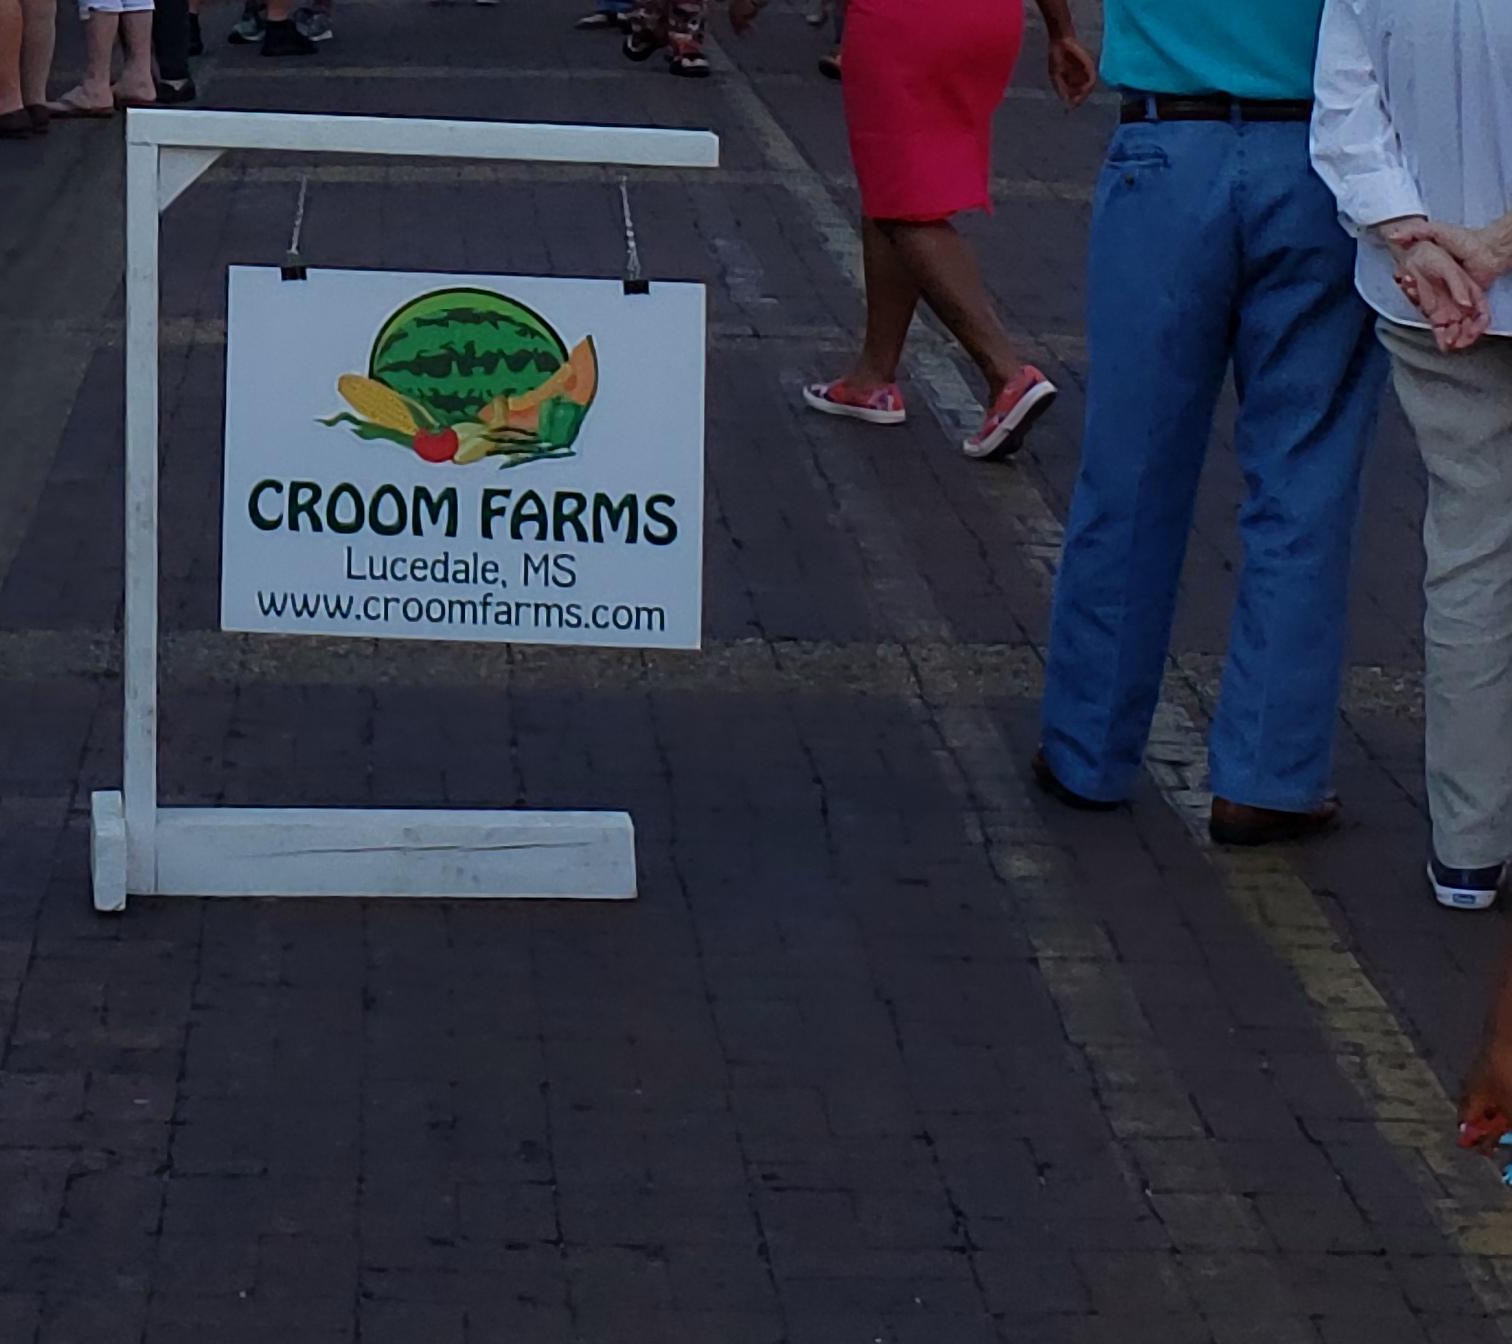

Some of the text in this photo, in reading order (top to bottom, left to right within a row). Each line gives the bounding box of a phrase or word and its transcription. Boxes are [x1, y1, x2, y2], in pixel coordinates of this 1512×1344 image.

[248, 479, 678, 546] CROOM FARMS
[346, 546, 577, 589] Lucedale, MS
[257, 591, 666, 631] www.croomfarms.com
